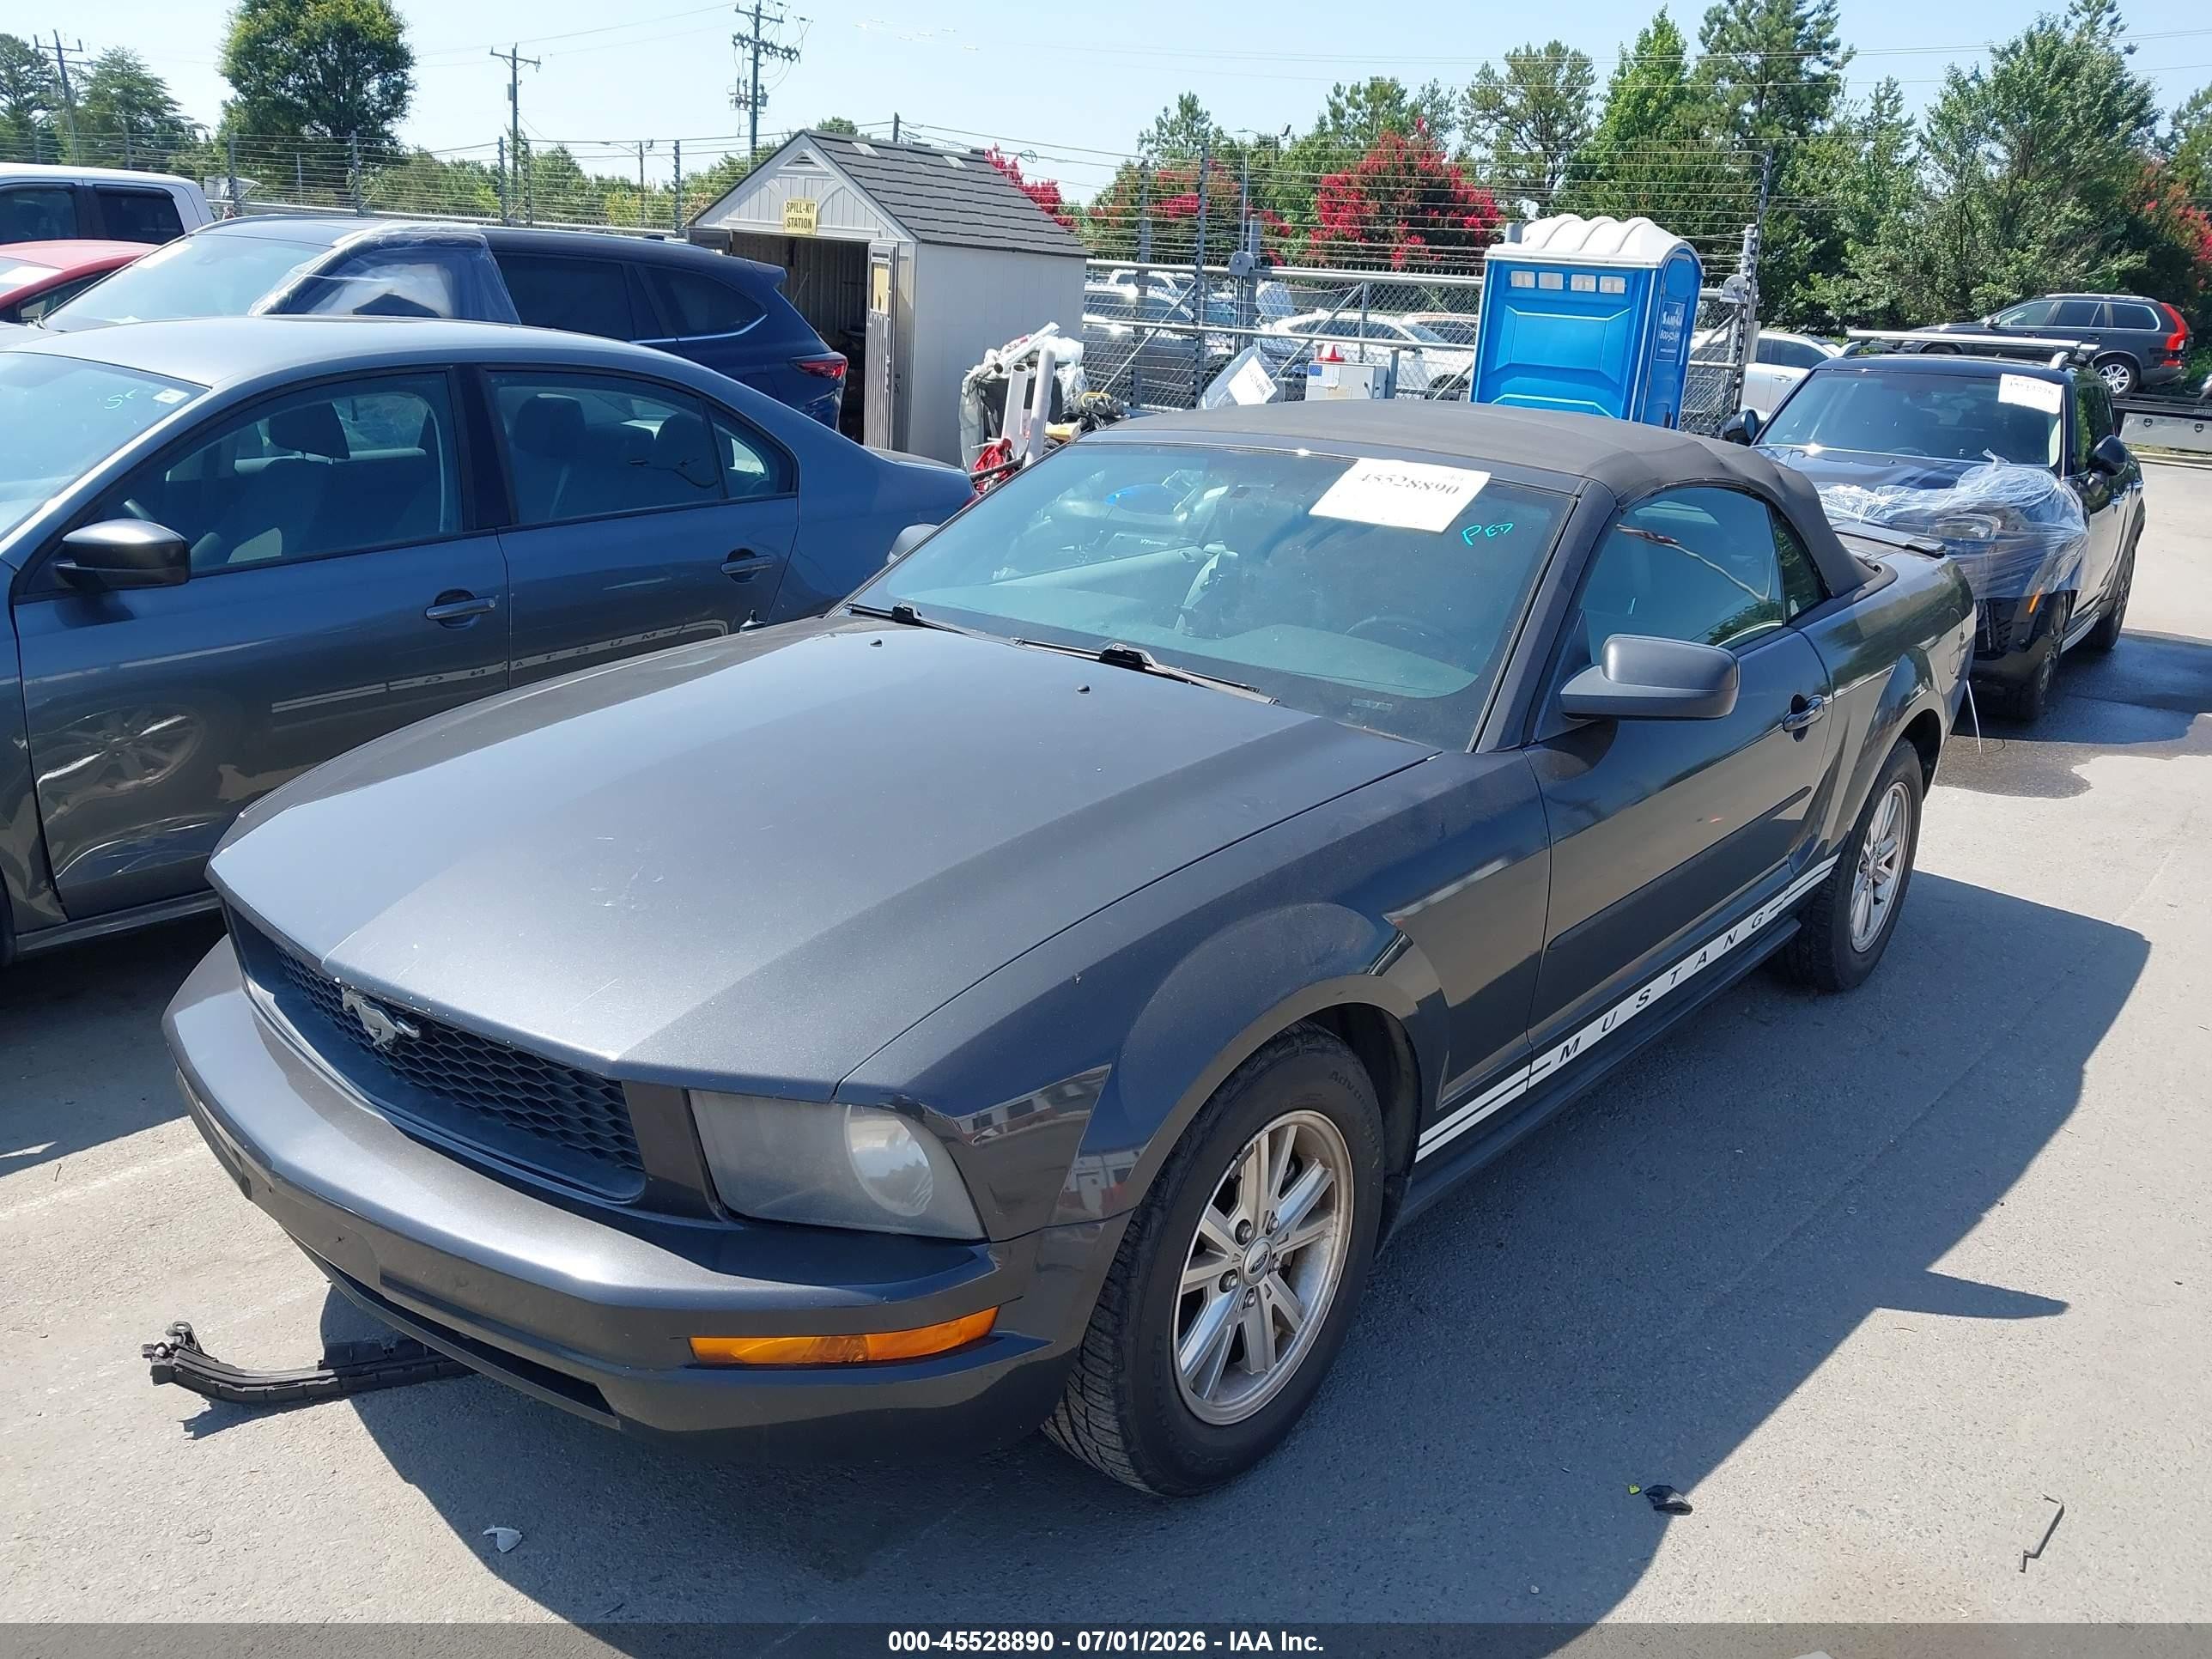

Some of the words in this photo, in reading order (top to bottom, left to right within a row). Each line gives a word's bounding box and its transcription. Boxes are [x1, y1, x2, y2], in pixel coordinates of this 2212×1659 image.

[786, 202, 816, 215] SPILL-KIT
[787, 216, 812, 229] STATION
[1559, 911, 1765, 1063] MUSTANG
